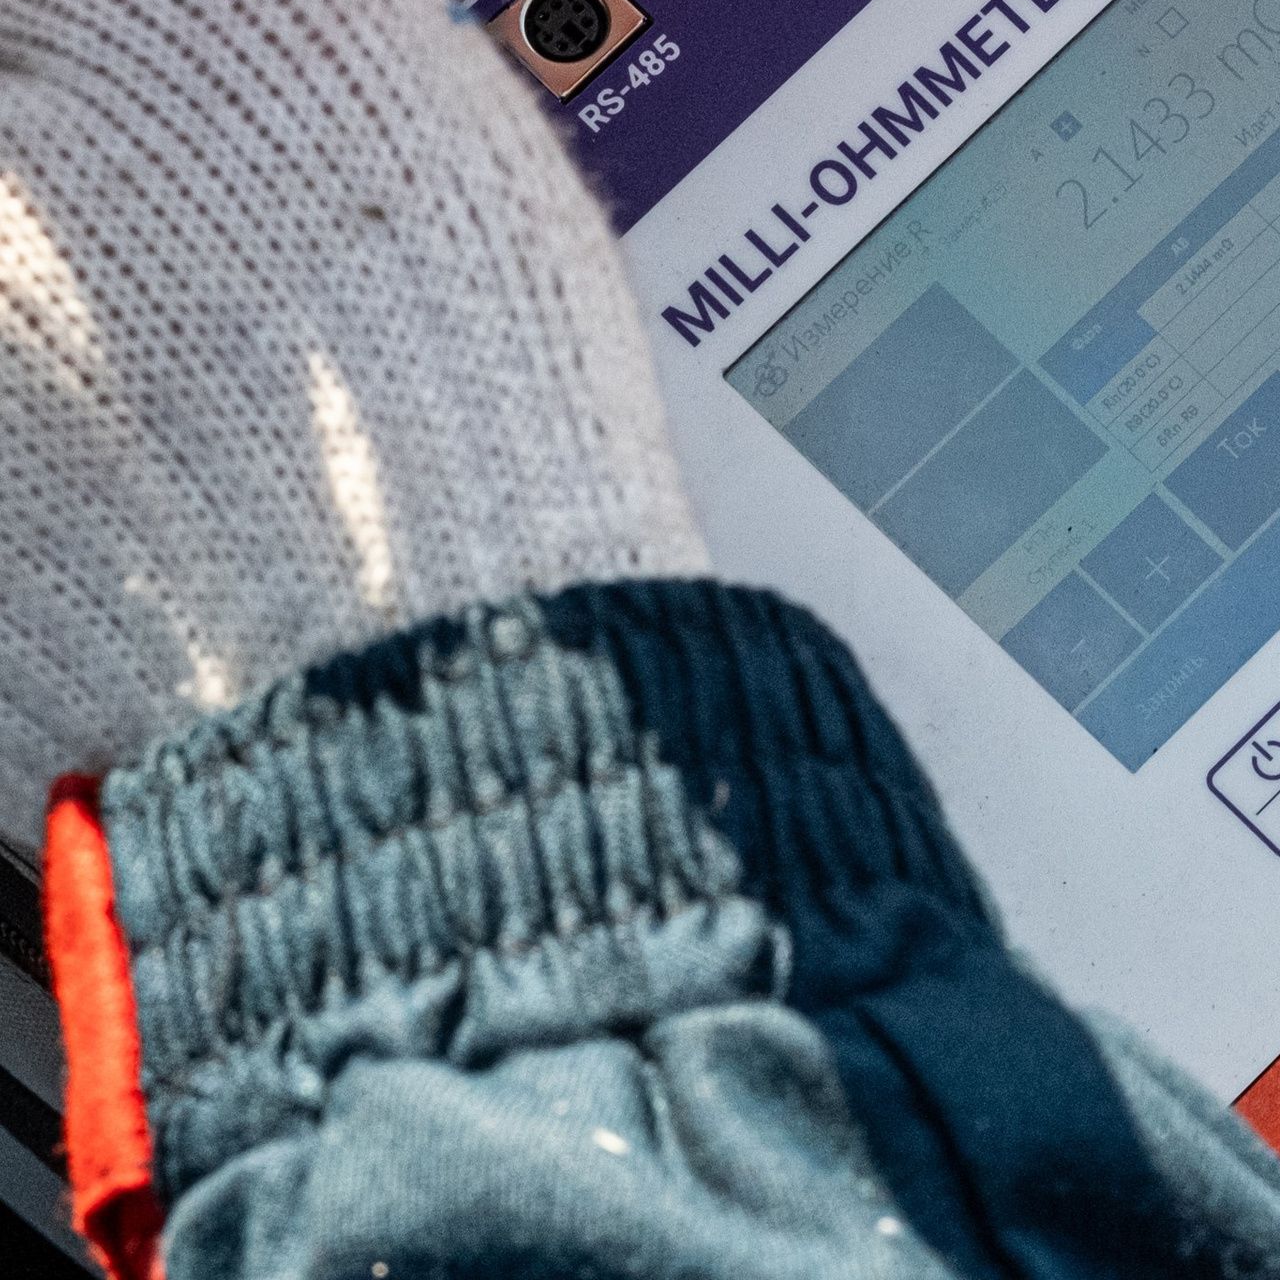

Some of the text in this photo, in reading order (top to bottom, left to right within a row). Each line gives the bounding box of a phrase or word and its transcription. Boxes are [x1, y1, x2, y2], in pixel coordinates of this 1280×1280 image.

[577, 33, 681, 133] RS-485
[1233, 104, 1280, 149] Идет
[1048, 64, 1224, 232] 2.1433
[780, 217, 933, 367] Измерение R
[1214, 410, 1269, 464] Ток
[1132, 647, 1210, 724] Закрыть
